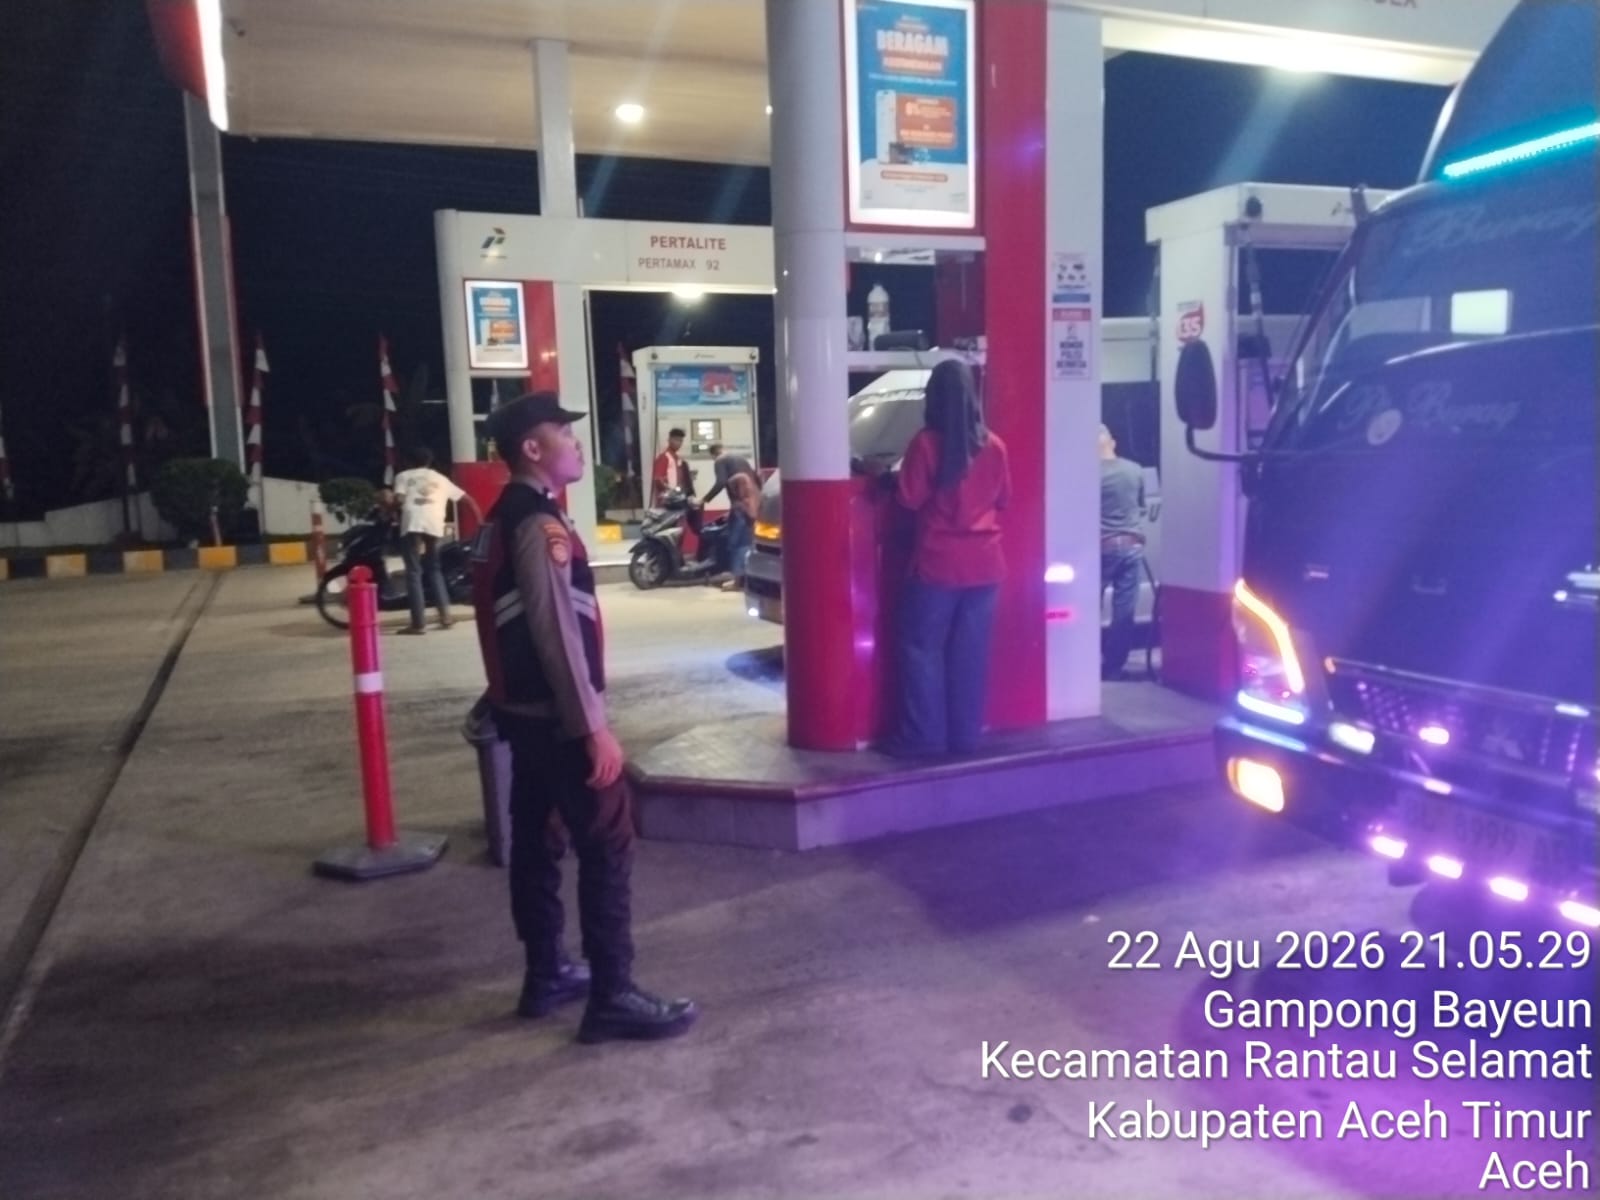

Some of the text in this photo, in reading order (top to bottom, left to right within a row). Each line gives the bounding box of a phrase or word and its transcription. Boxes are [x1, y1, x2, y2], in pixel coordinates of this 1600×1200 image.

[650, 235, 727, 250] PERTALITE
[638, 257, 721, 271] PERTAMAX 92
